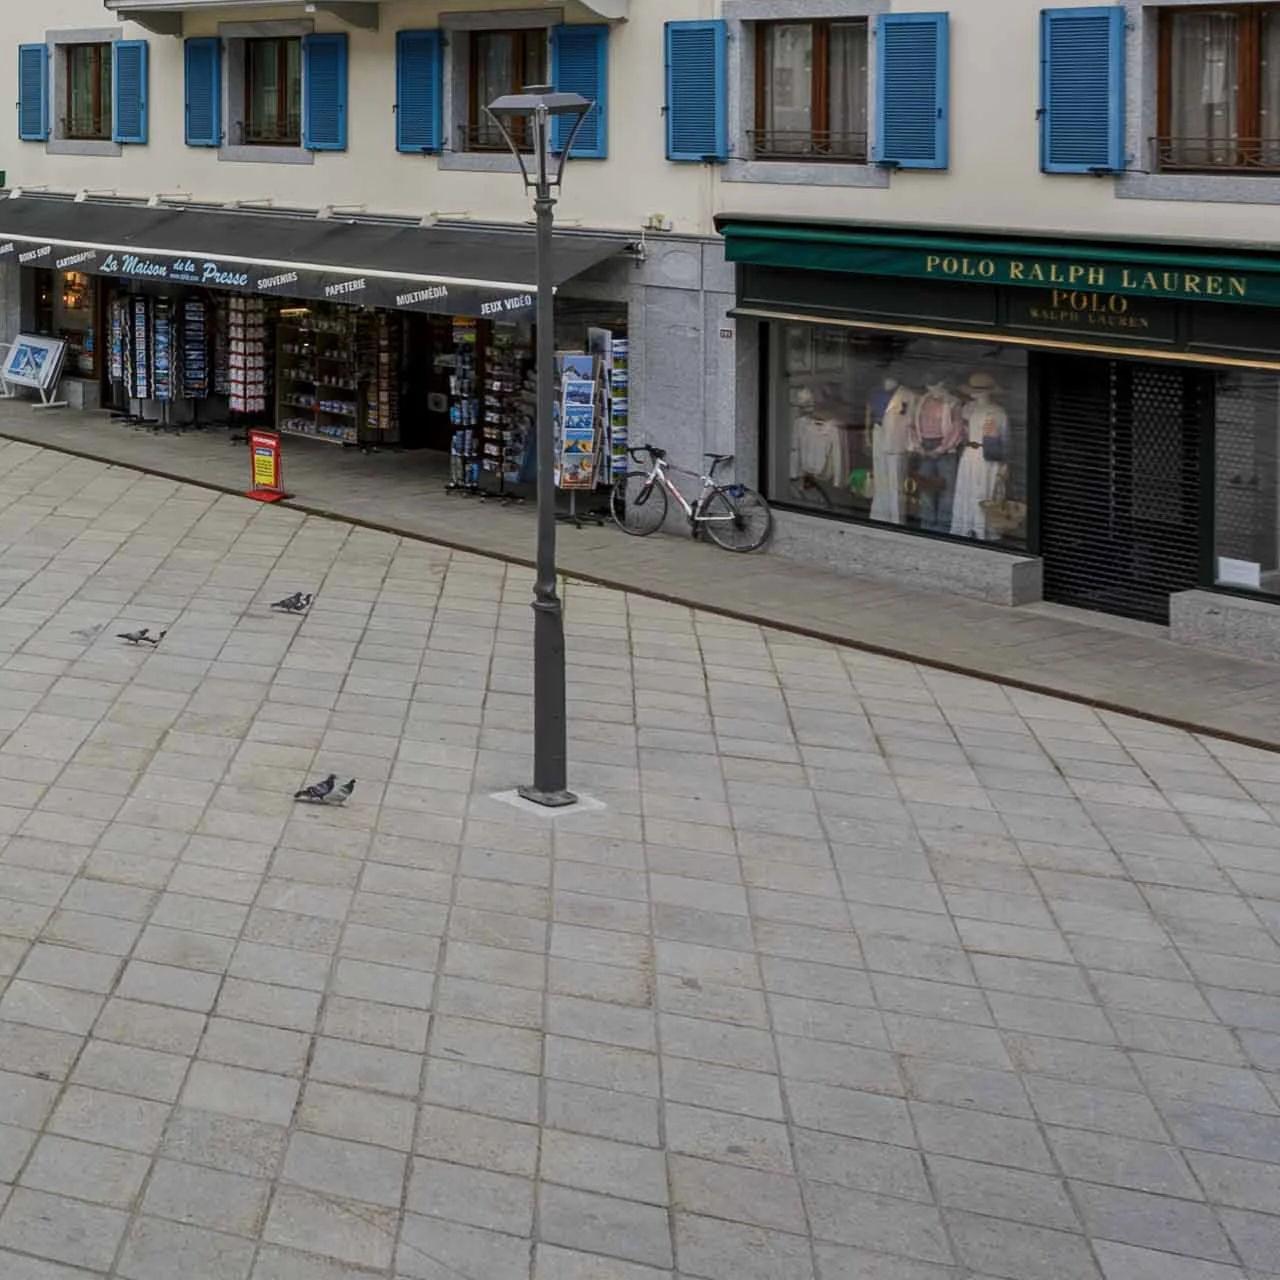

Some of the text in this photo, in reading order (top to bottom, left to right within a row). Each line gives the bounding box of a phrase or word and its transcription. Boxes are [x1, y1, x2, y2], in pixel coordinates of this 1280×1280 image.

[55, 249, 97, 269] CARTOGRAPHIE
[100, 253, 119, 273] La
[121, 254, 168, 277] Maison
[173, 259, 184, 272] de
[184, 259, 196, 272] la
[200, 262, 248, 287] Presse
[256, 271, 298, 290] SOUVENIRS
[926, 254, 1248, 297] POLO RALPH LAUREN
[324, 278, 368, 297] PAPETERIE
[395, 285, 449, 306] MULTIMÉDIA
[480, 300, 503, 315] JEUX
[1051, 288, 1128, 314] POLO
[1028, 306, 1151, 330] RALPH LAUREN
